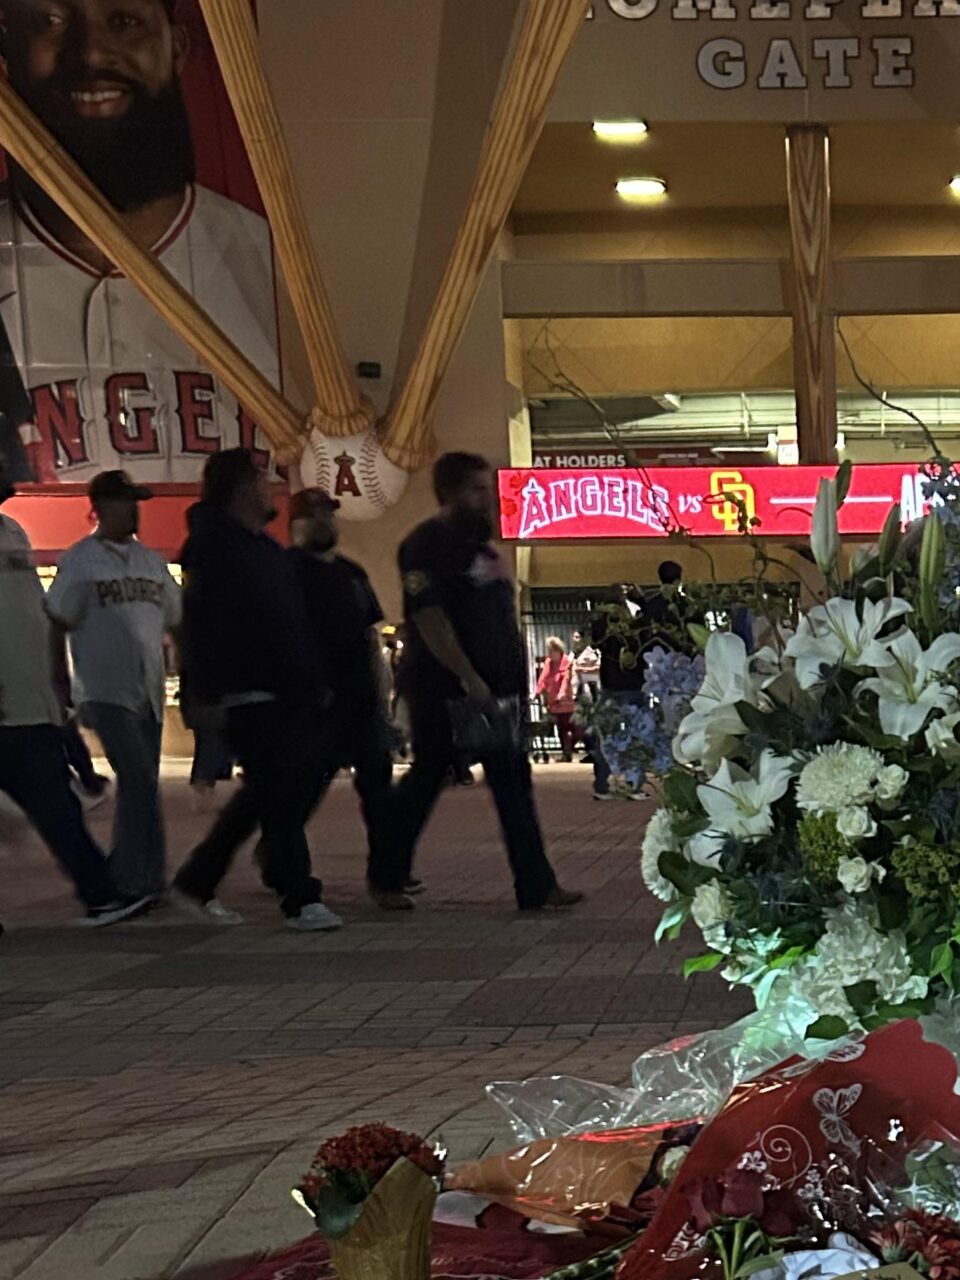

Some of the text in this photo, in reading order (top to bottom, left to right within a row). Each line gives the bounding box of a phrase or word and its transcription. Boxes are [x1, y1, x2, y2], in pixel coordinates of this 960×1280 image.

[697, 38, 914, 88] GATE
[556, 454, 626, 468] HOLDERS
[519, 478, 668, 538] ANGELS
